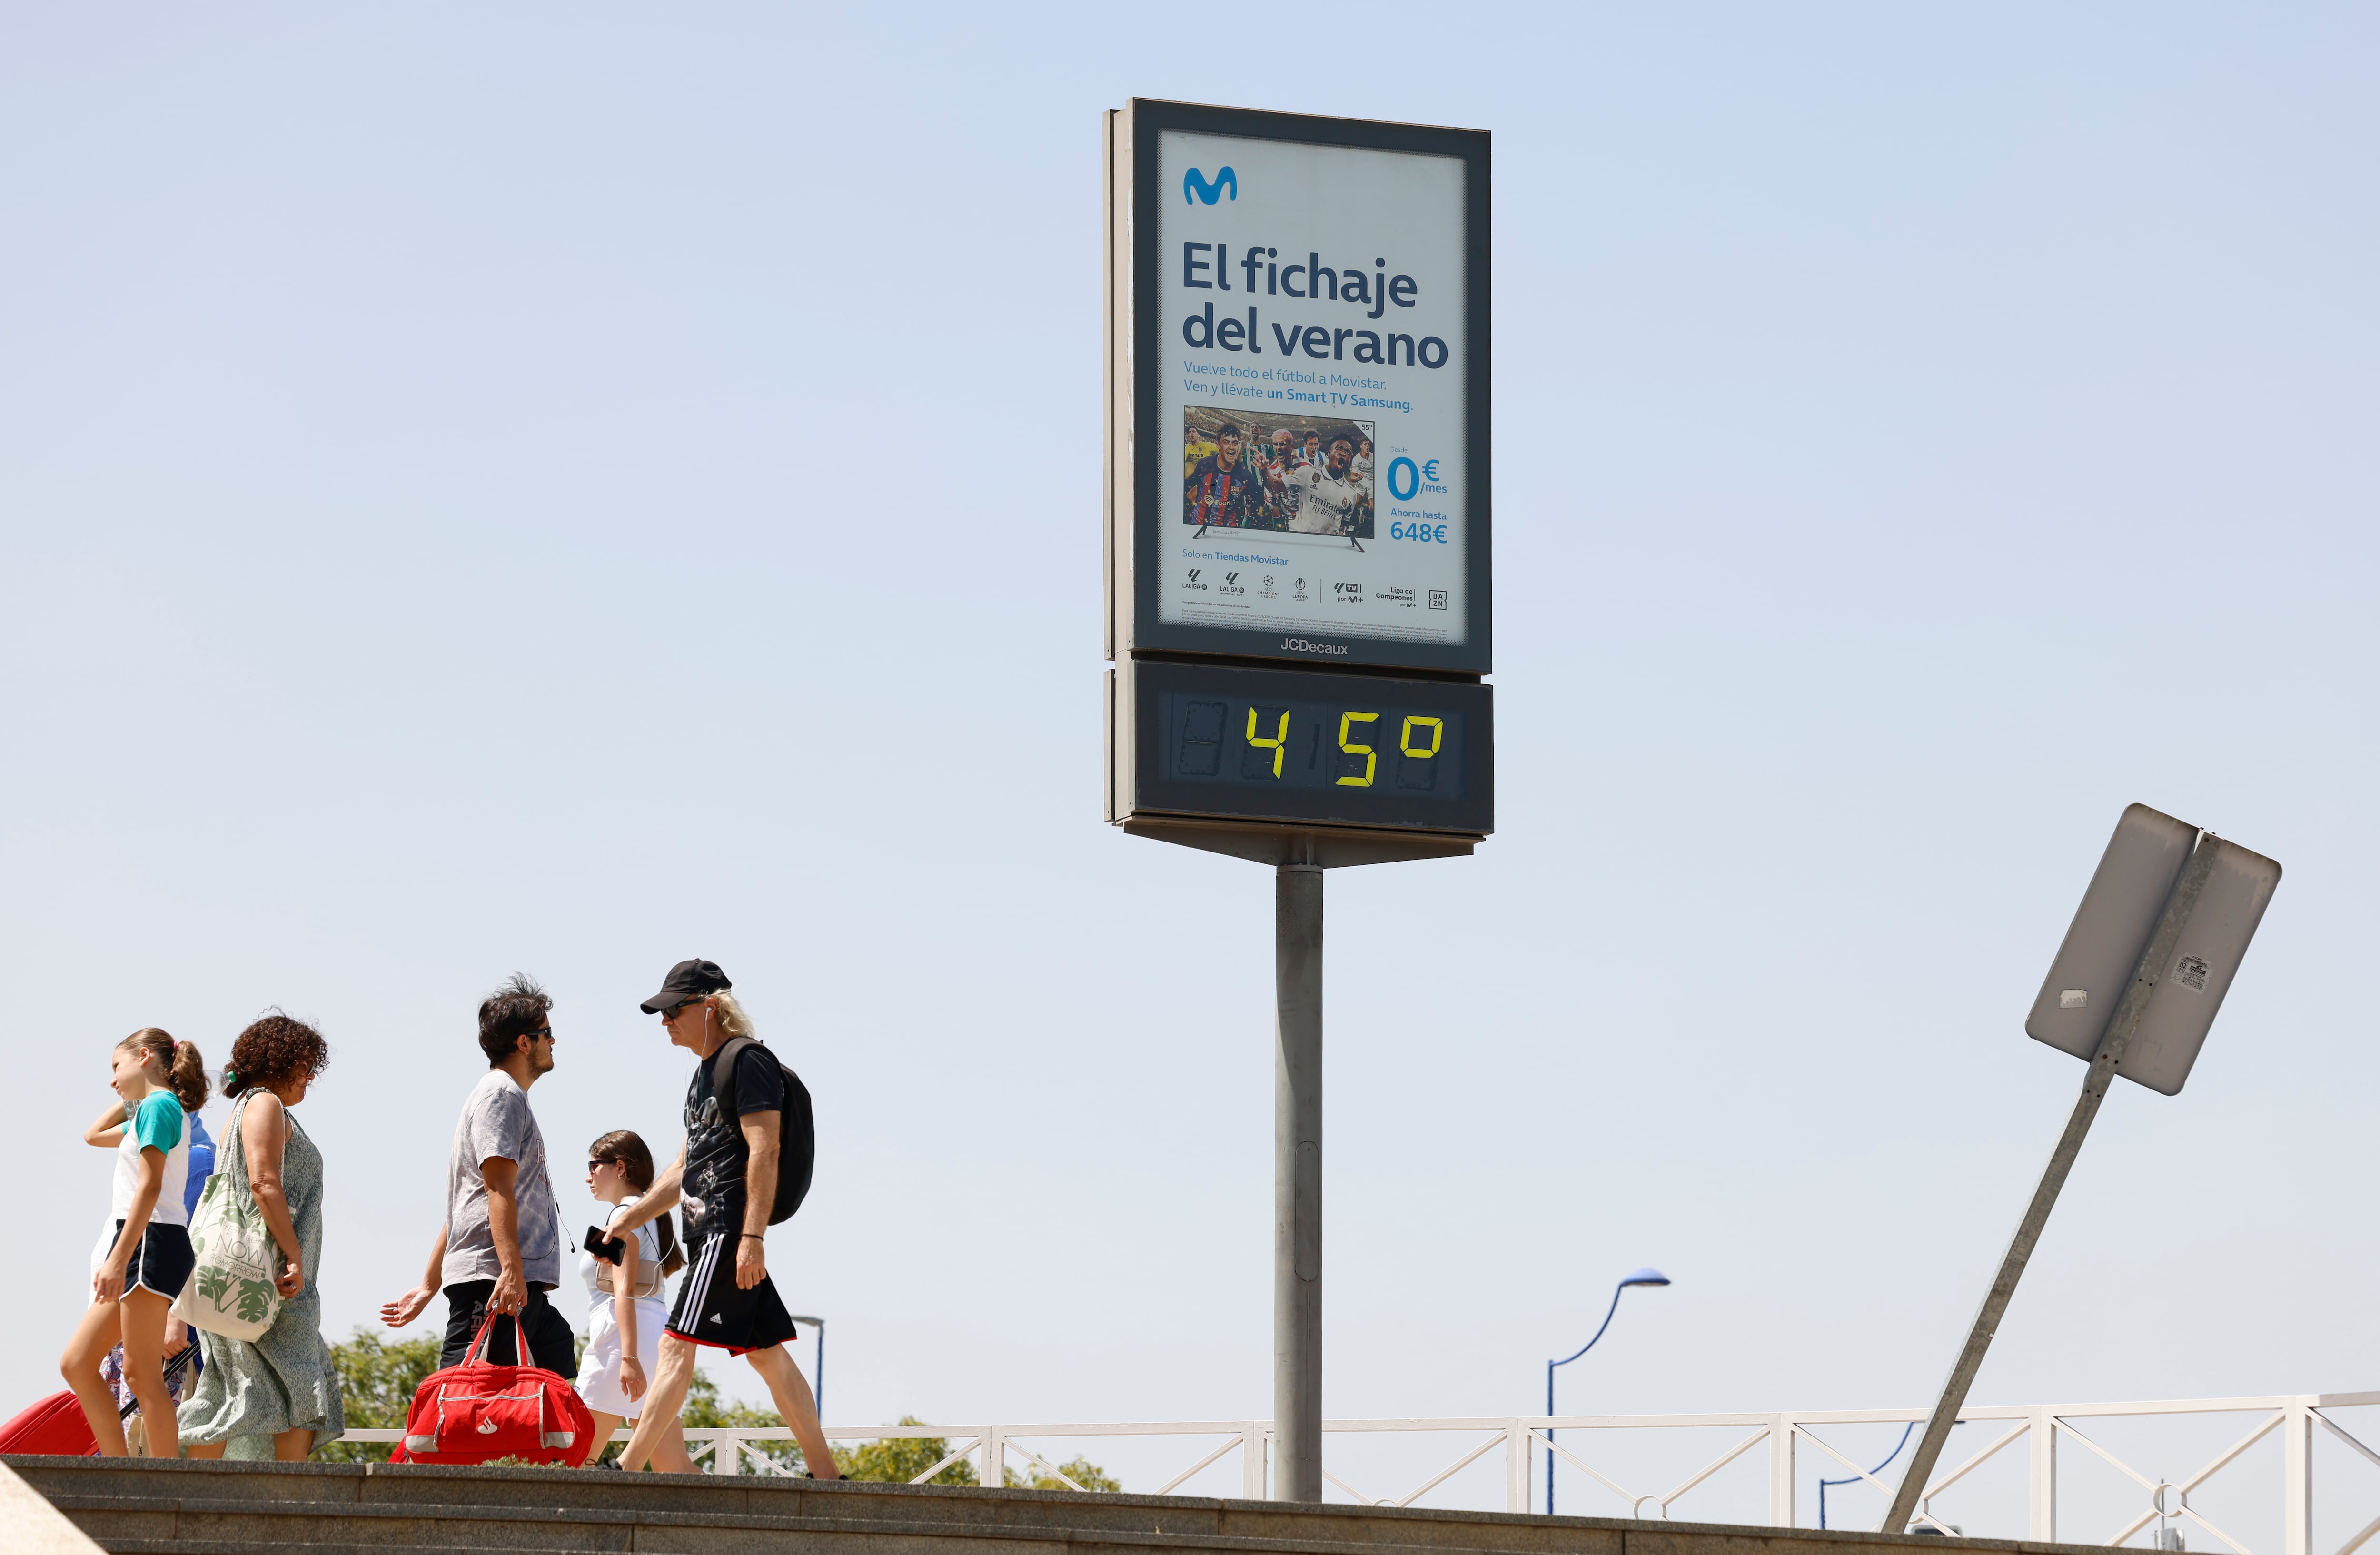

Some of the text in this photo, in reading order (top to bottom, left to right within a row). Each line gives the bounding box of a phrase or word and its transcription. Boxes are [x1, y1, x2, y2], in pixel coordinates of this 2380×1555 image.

[1183, 242, 1418, 319] El fichaje
[1183, 302, 1448, 369] del verano
[1184, 361, 1387, 390] Vuelve todo el fútbol a Movistar.
[1184, 379, 1414, 413] Ven y llévate un Smart TV Samsung.
[1312, 505, 1336, 520] FLY BETTER
[1390, 508, 1447, 520] Ahorra hasta
[1390, 521, 1448, 544] 648€
[1182, 549, 1200, 559] Solo
[1215, 552, 1249, 562] Tiendas
[1251, 555, 1289, 565] Movistar
[1376, 593, 1413, 601] Campeones
[1280, 638, 1349, 655] JCDecaux
[215, 1233, 264, 1265] NOW
[211, 1254, 260, 1279] TOMORROW
